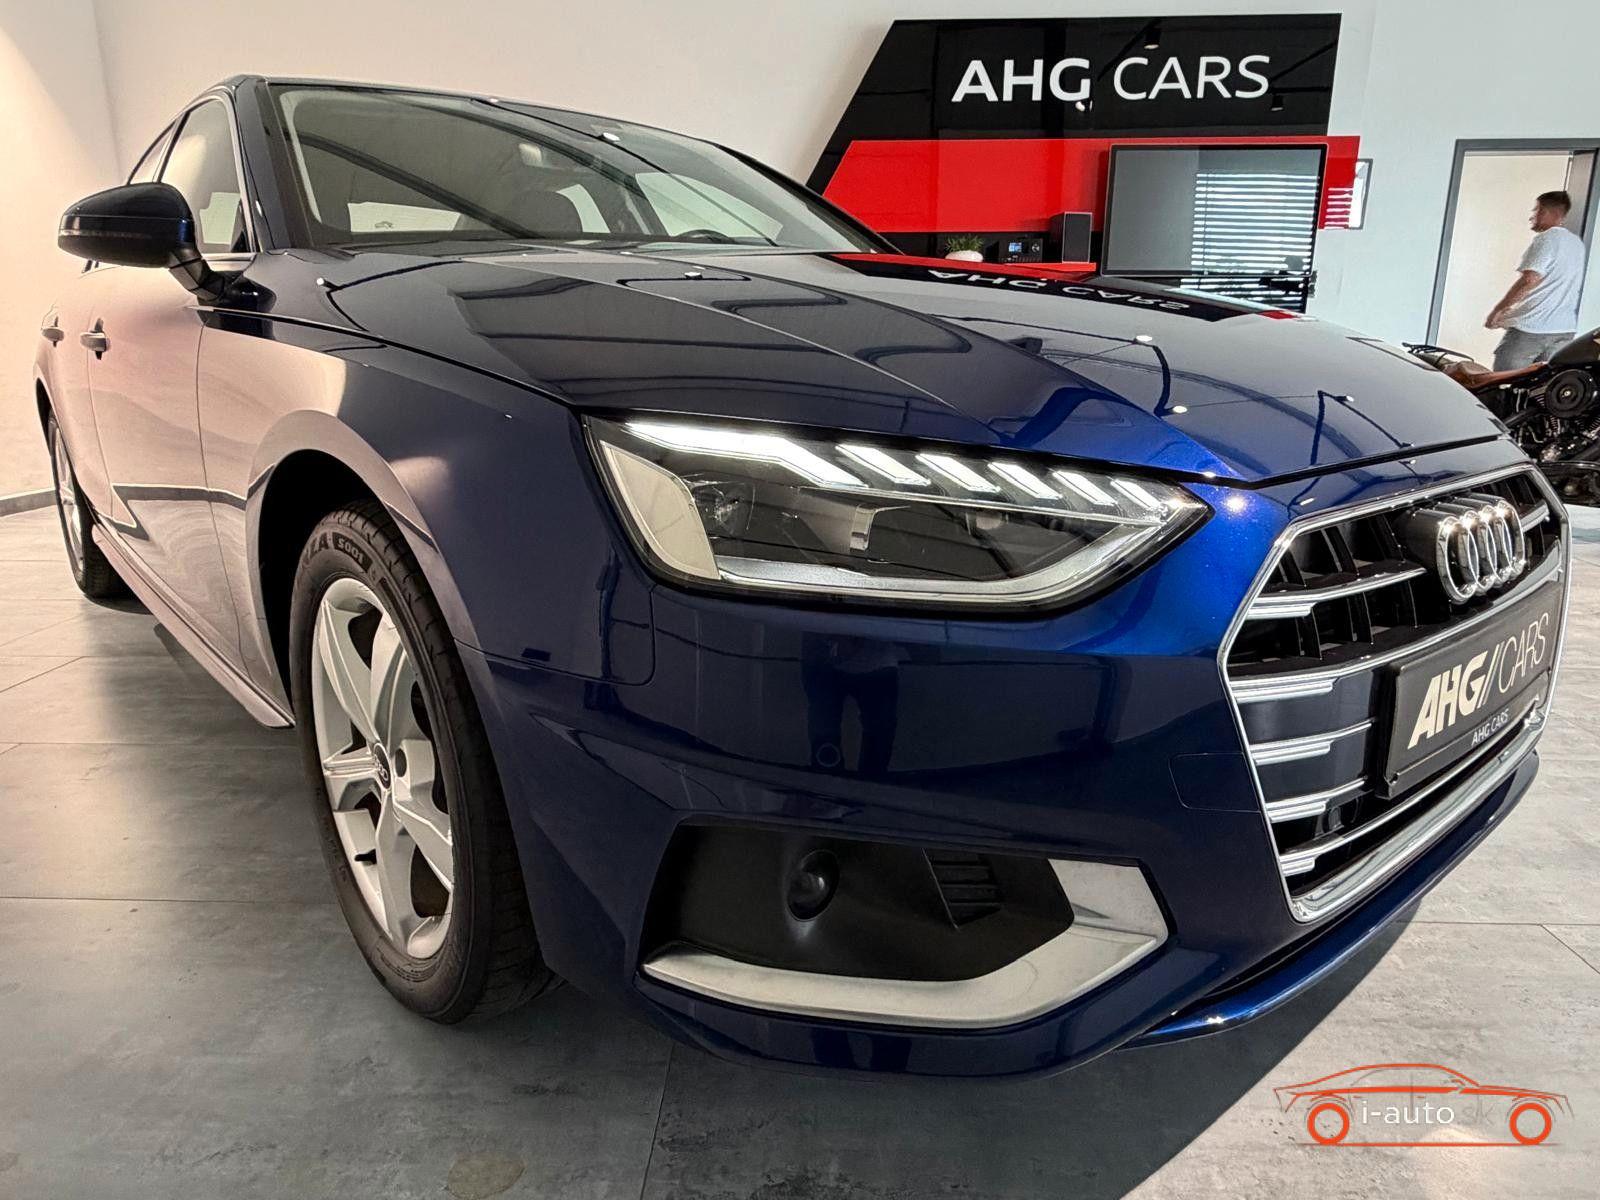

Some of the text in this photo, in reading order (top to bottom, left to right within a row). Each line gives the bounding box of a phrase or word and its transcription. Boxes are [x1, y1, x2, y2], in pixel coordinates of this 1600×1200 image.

[951, 55, 1270, 102] AHG CARS
[1471, 708, 1509, 748] AHG CARS
